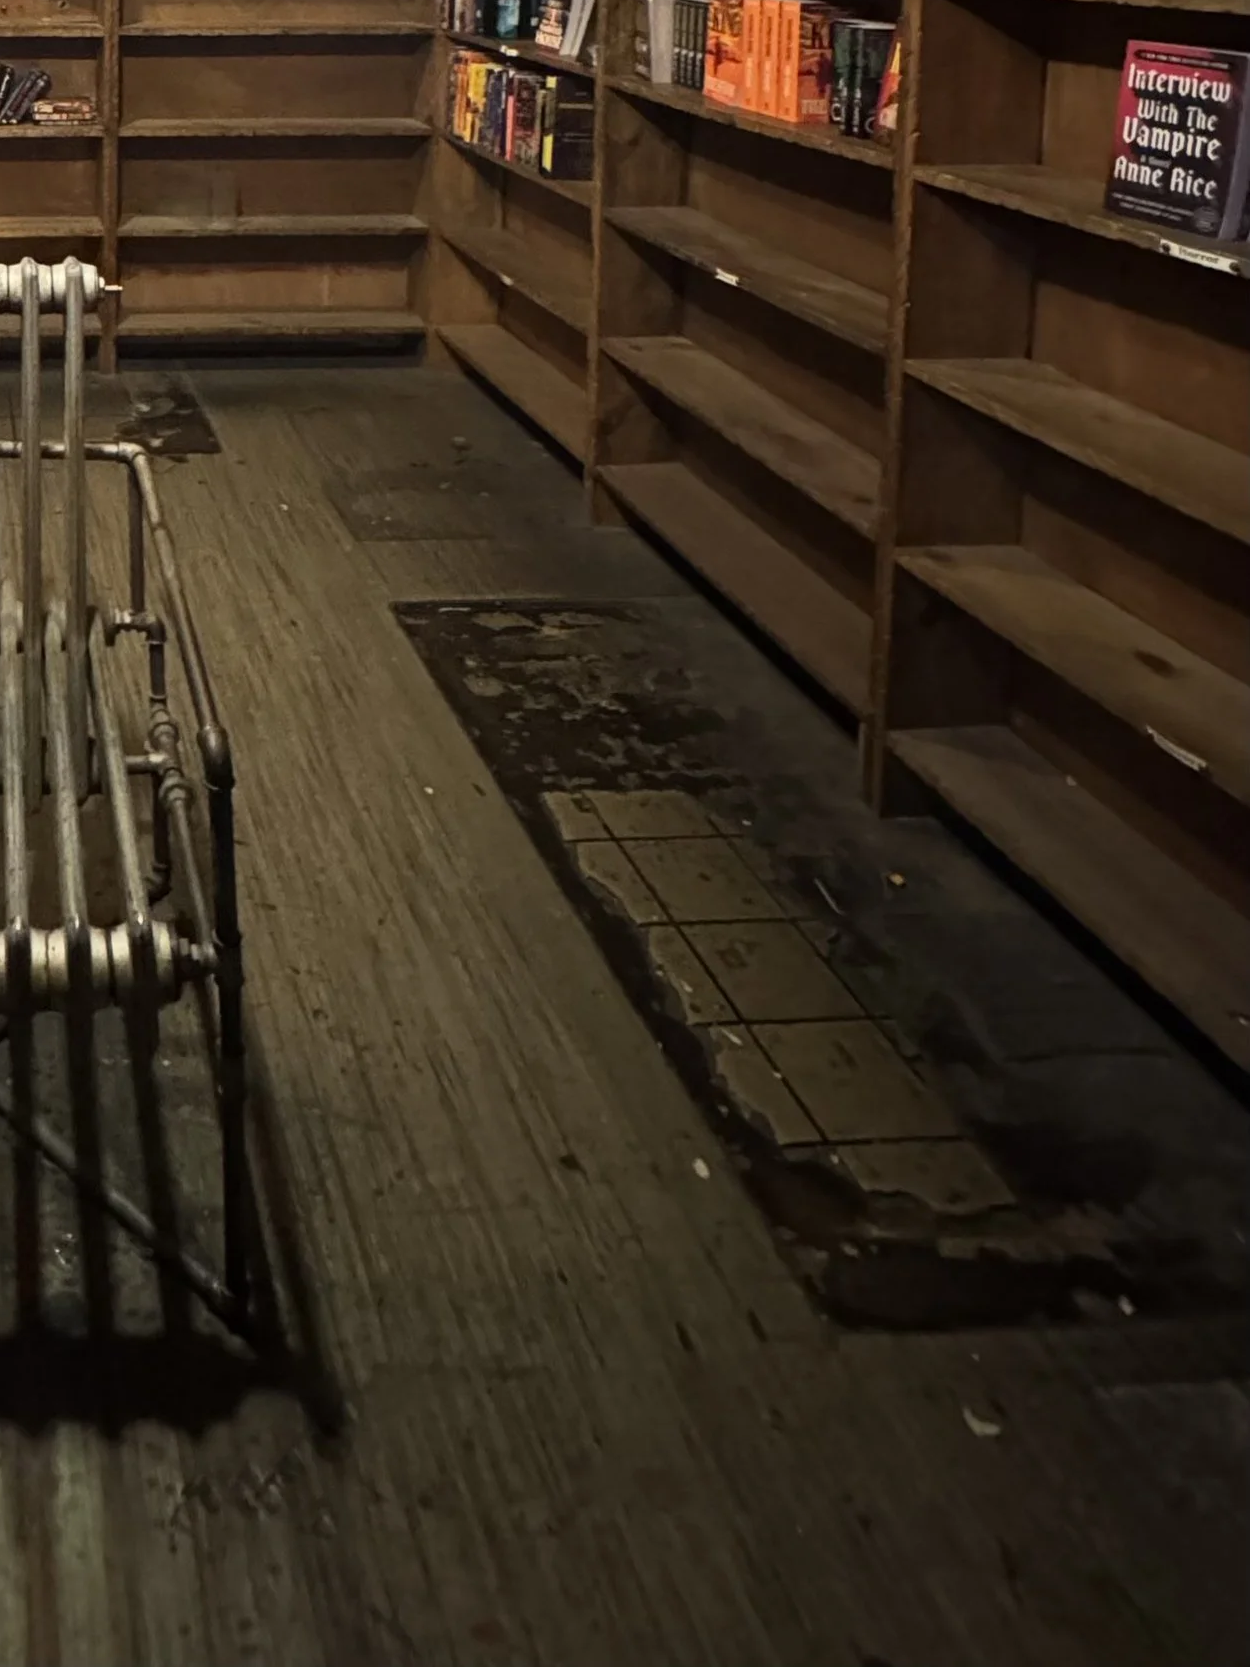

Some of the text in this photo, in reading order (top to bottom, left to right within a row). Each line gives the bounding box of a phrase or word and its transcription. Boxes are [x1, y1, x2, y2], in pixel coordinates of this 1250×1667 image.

[1127, 63, 1232, 104] Interview
[1137, 97, 1219, 133] With The
[1122, 116, 1222, 162] Vampire
[1113, 156, 1218, 200] Anne Rice
